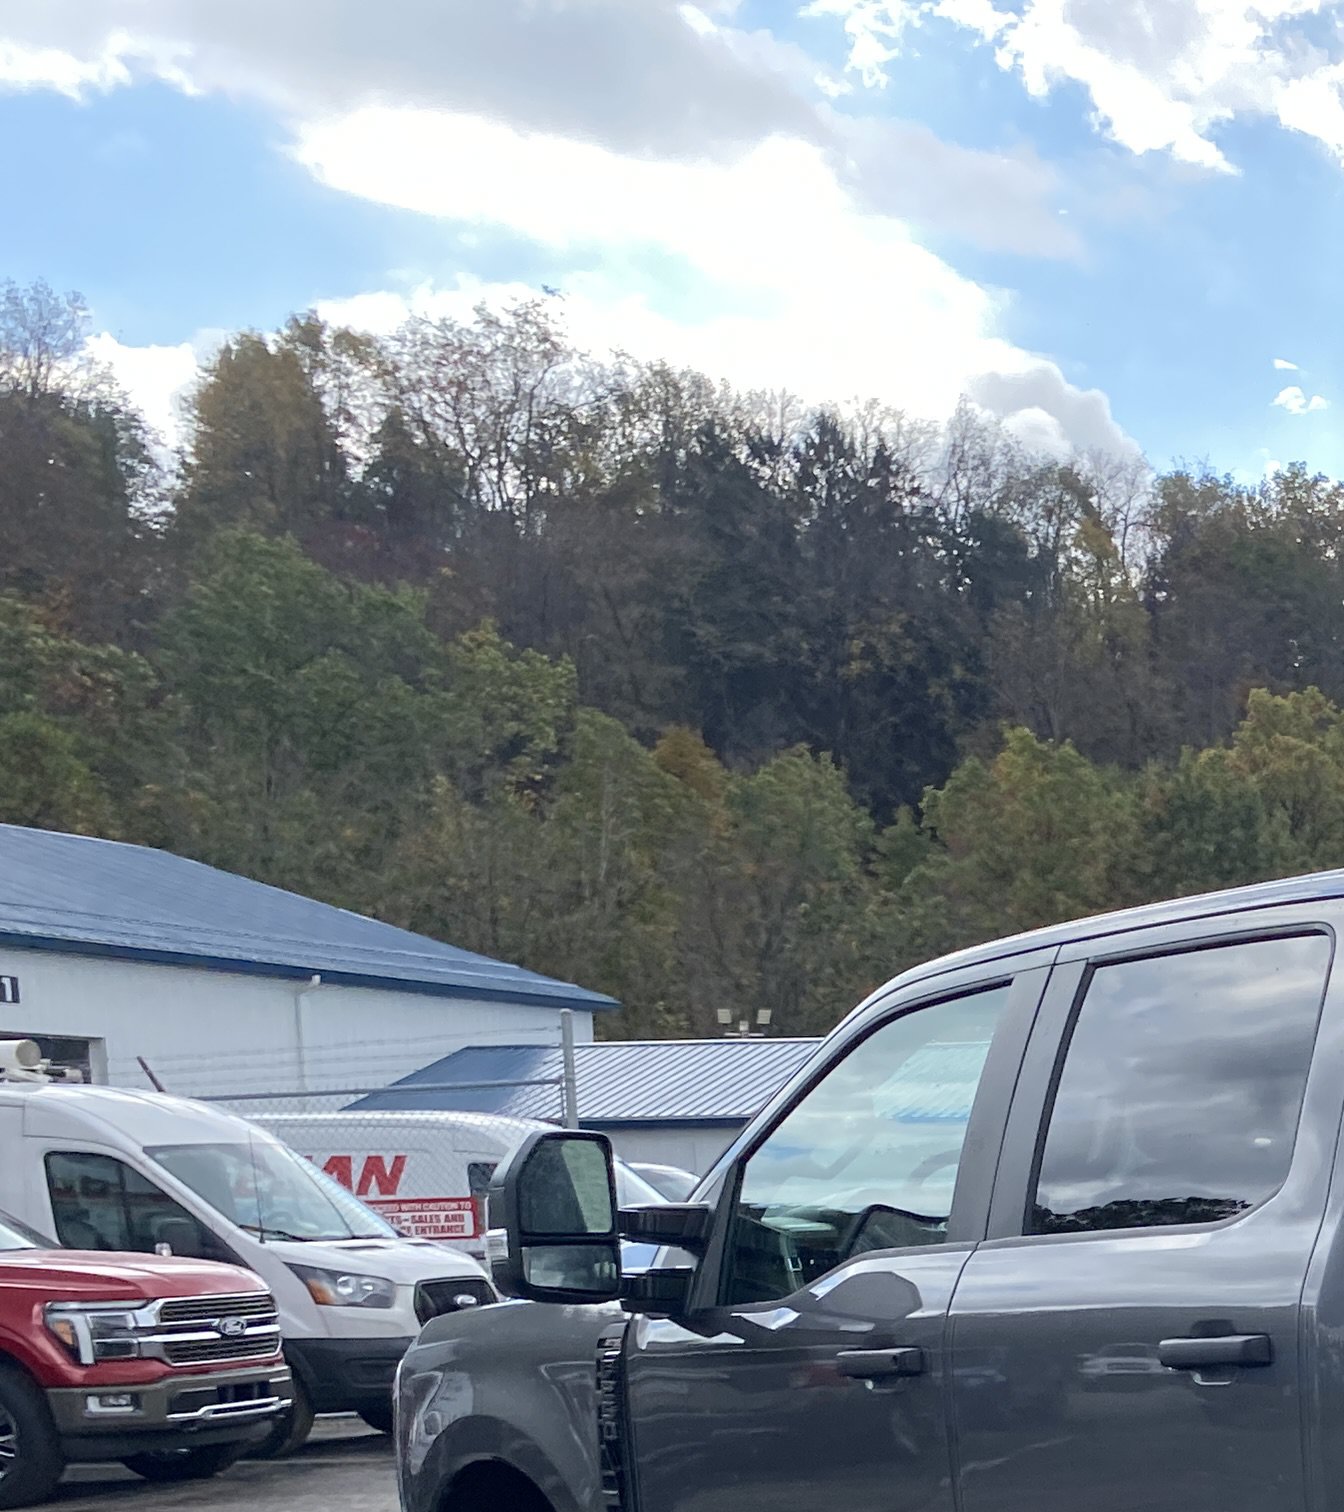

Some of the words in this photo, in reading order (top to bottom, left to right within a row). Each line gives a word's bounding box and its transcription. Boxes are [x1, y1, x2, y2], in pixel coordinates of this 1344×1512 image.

[423, 1201, 459, 1211] CAUTION
[460, 1201, 472, 1210] TO
[444, 1213, 465, 1224] AND
[415, 1224, 465, 1236] ENTRANCE
